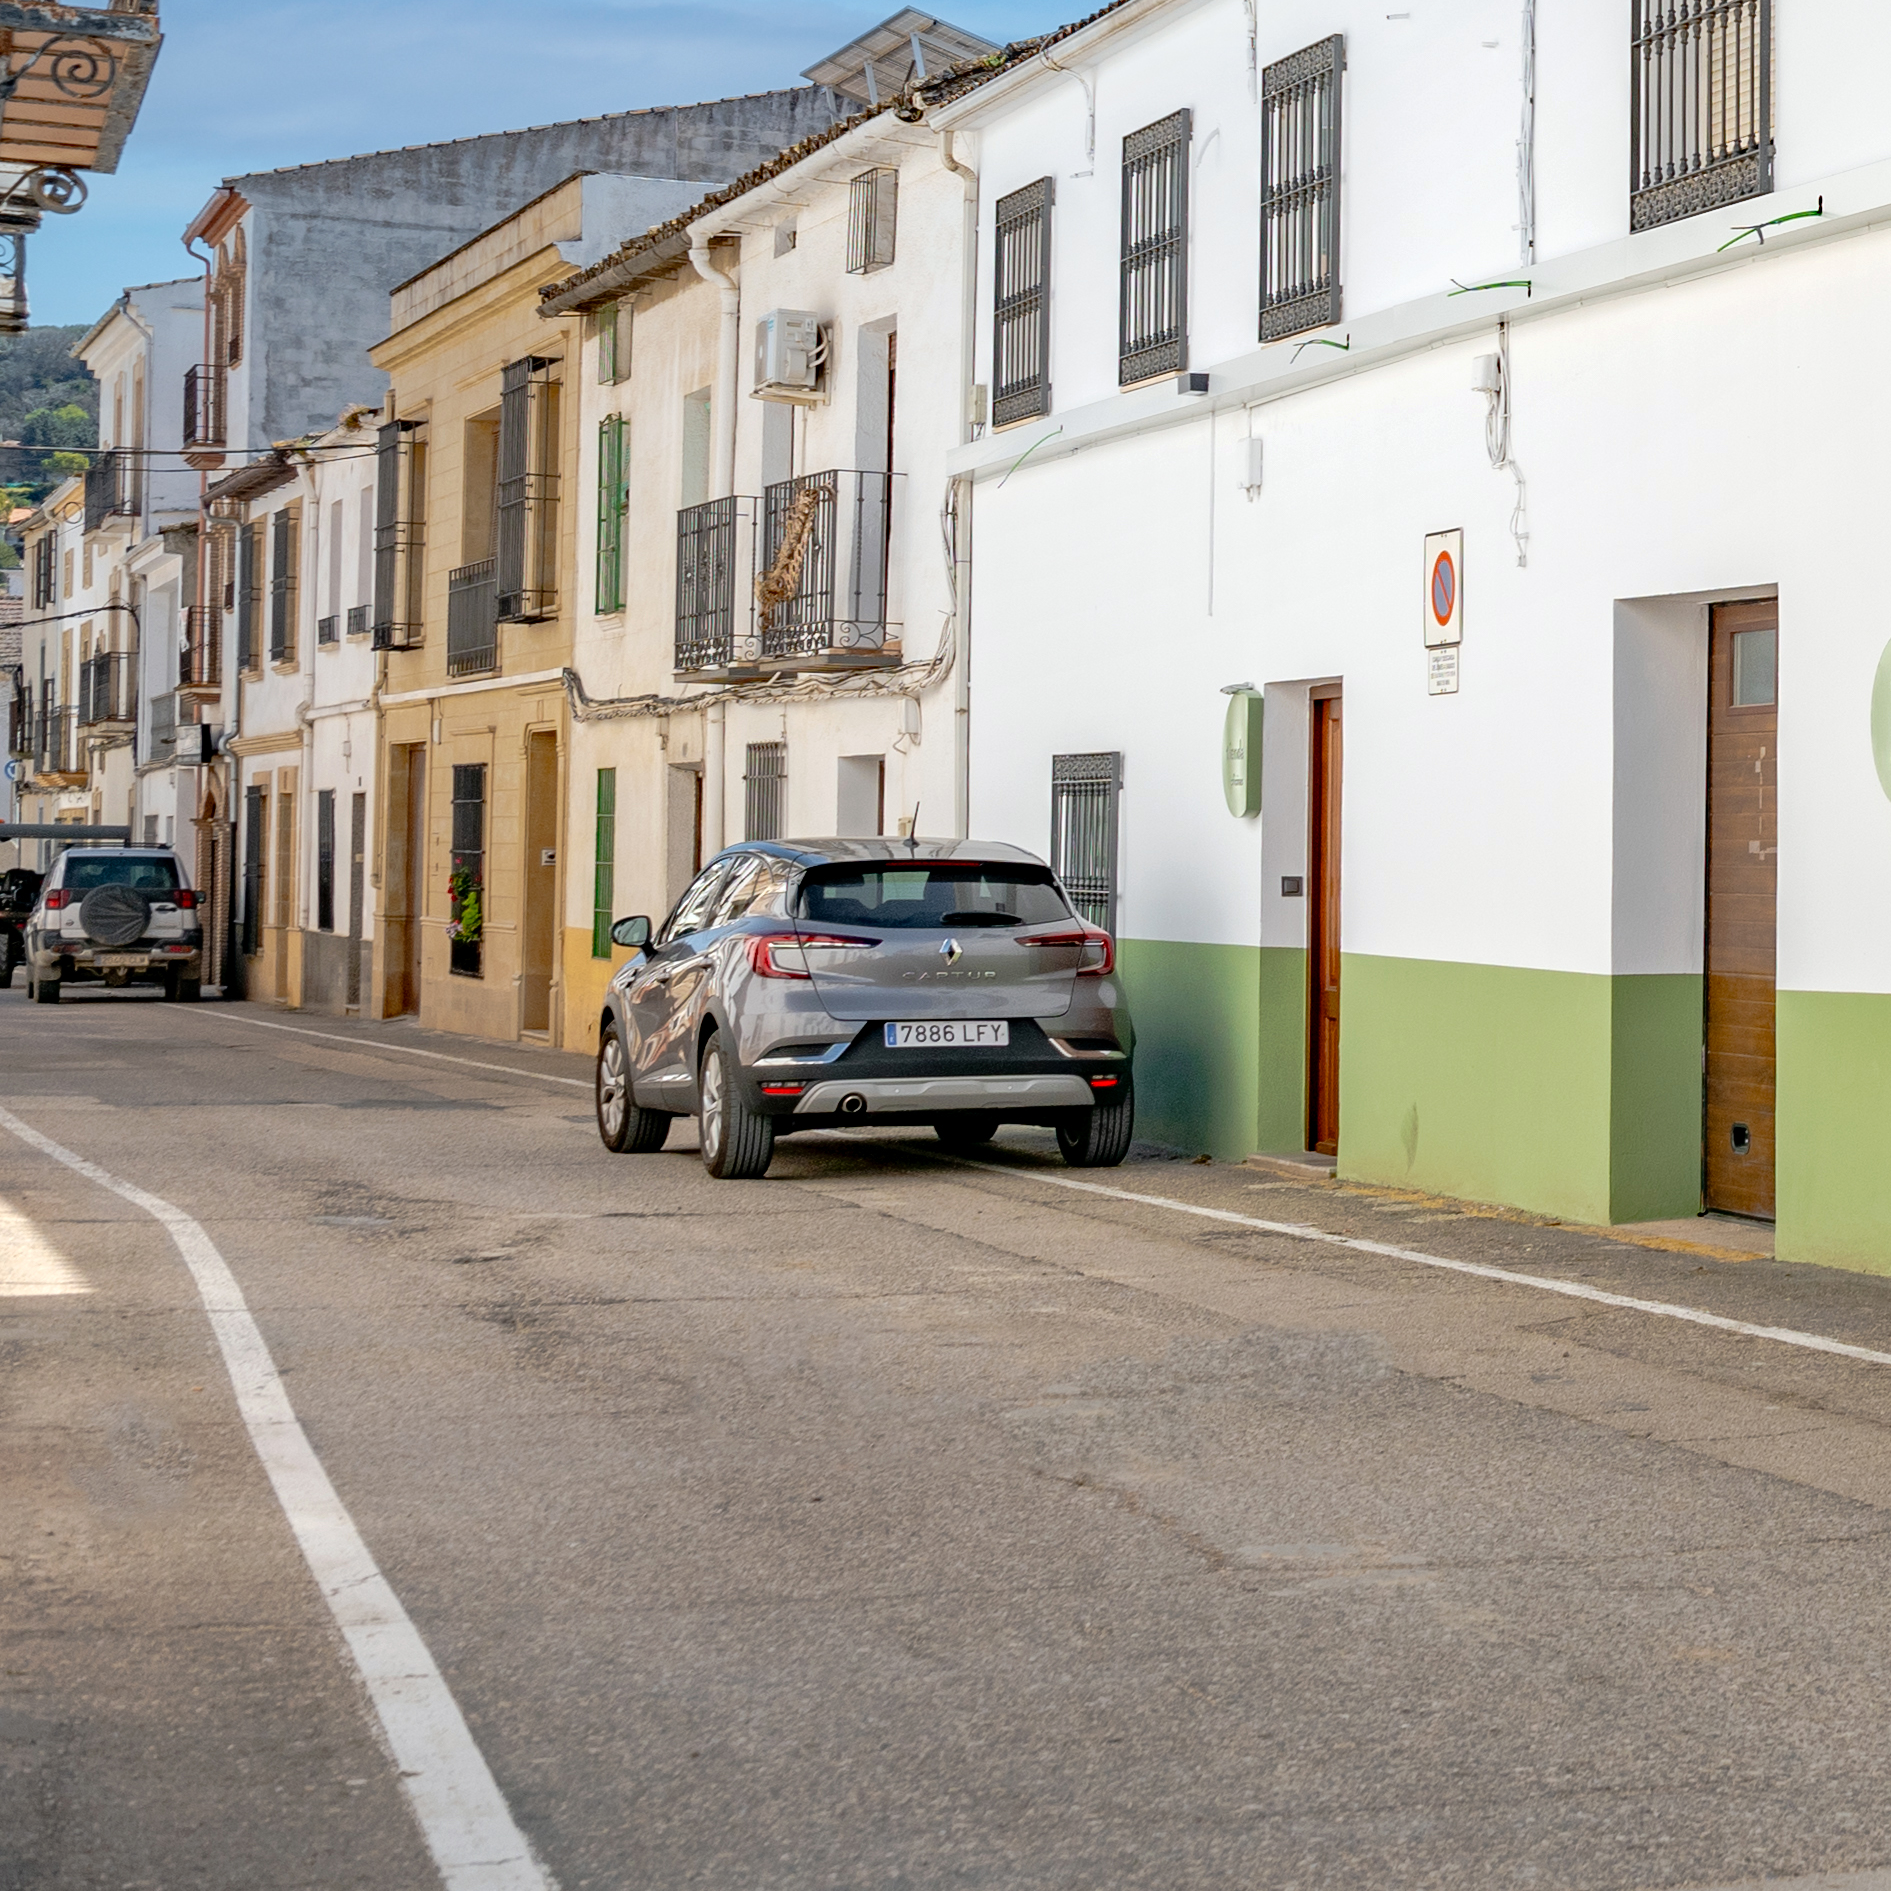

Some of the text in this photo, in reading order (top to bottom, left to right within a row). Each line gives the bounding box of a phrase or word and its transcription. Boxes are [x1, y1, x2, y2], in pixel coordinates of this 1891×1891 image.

[902, 971, 996, 980] CAPTUR
[900, 1023, 1003, 1043] 7886 LFY
